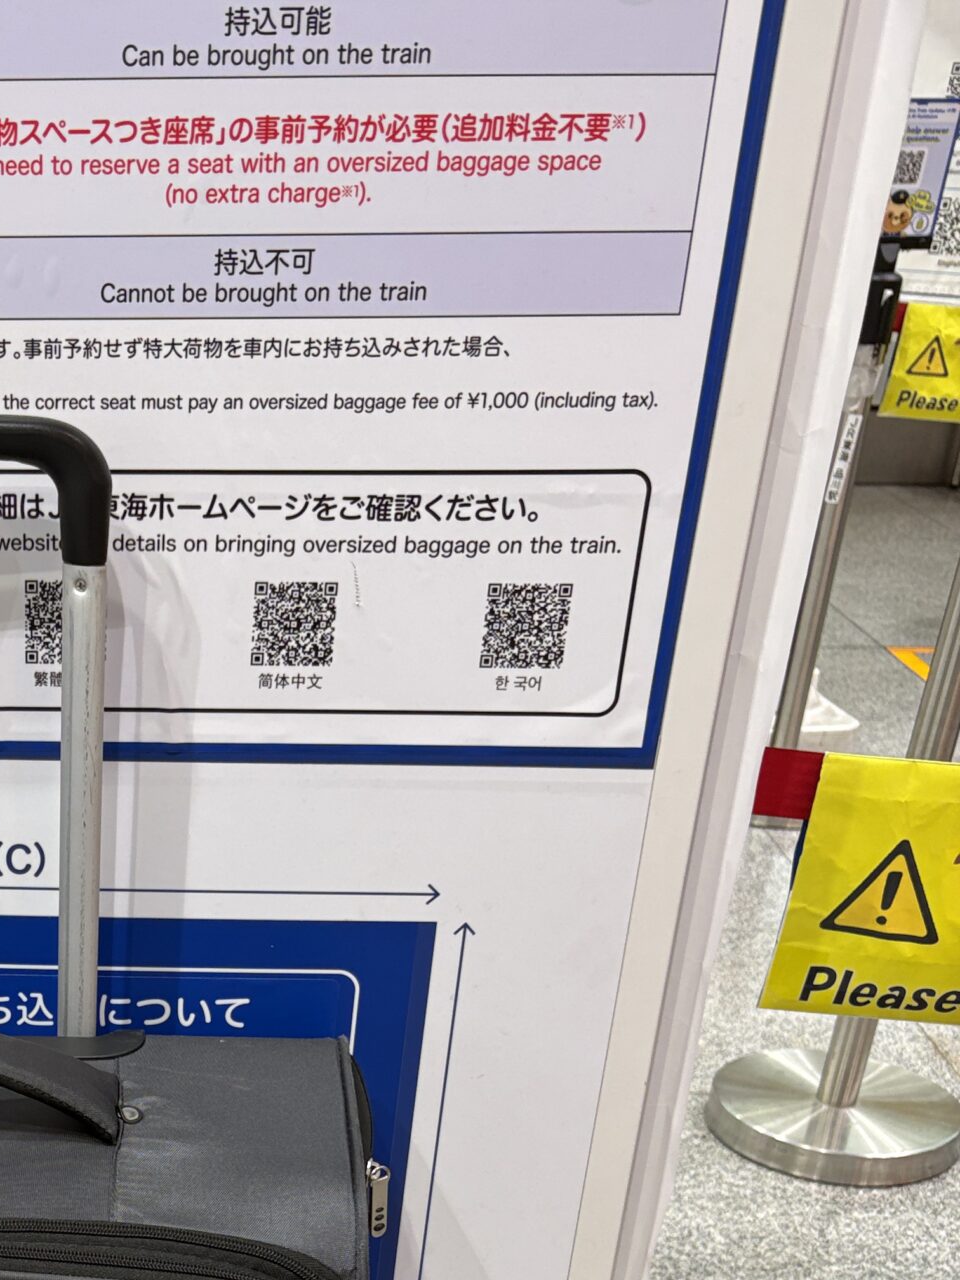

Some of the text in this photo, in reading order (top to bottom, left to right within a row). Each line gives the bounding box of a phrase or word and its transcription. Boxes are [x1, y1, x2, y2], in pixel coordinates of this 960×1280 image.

[223, 4, 333, 38] 持込可能
[121, 42, 432, 72] Can be brought on the train
[49, 155, 74, 177] to
[80, 157, 161, 176] reserve
[167, 157, 181, 176] a
[186, 153, 235, 175] seat
[240, 151, 287, 175] with
[292, 155, 320, 174] an
[326, 149, 431, 174] oversized
[435, 149, 531, 178] baggage
[536, 153, 603, 177] space
[165, 182, 199, 209] (no
[204, 183, 261, 205] extra
[213, 247, 317, 277] 持込不可
[100, 280, 428, 308] Cannot be brought on the train
[1, 392, 31, 411] the
[34, 394, 96, 411] correct
[99, 394, 137, 411] seat
[140, 393, 184, 411] must
[187, 396, 219, 415] pay
[222, 396, 244, 411] an
[248, 392, 329, 411] oversized
[332, 392, 407, 415] baggage
[411, 391, 440, 410] fee
[443, 391, 464, 410] of
[466, 390, 530, 412] ¥1,000
[533, 390, 617, 413] (including
[621, 390, 659, 411] tax).
[896, 390, 959, 412] Please
[111, 533, 622, 559] details on bringing oversized baggage on the train.
[34, 671, 61, 687] 繁體
[257, 672, 324, 691] 简体中文
[798, 965, 960, 1014] Please
